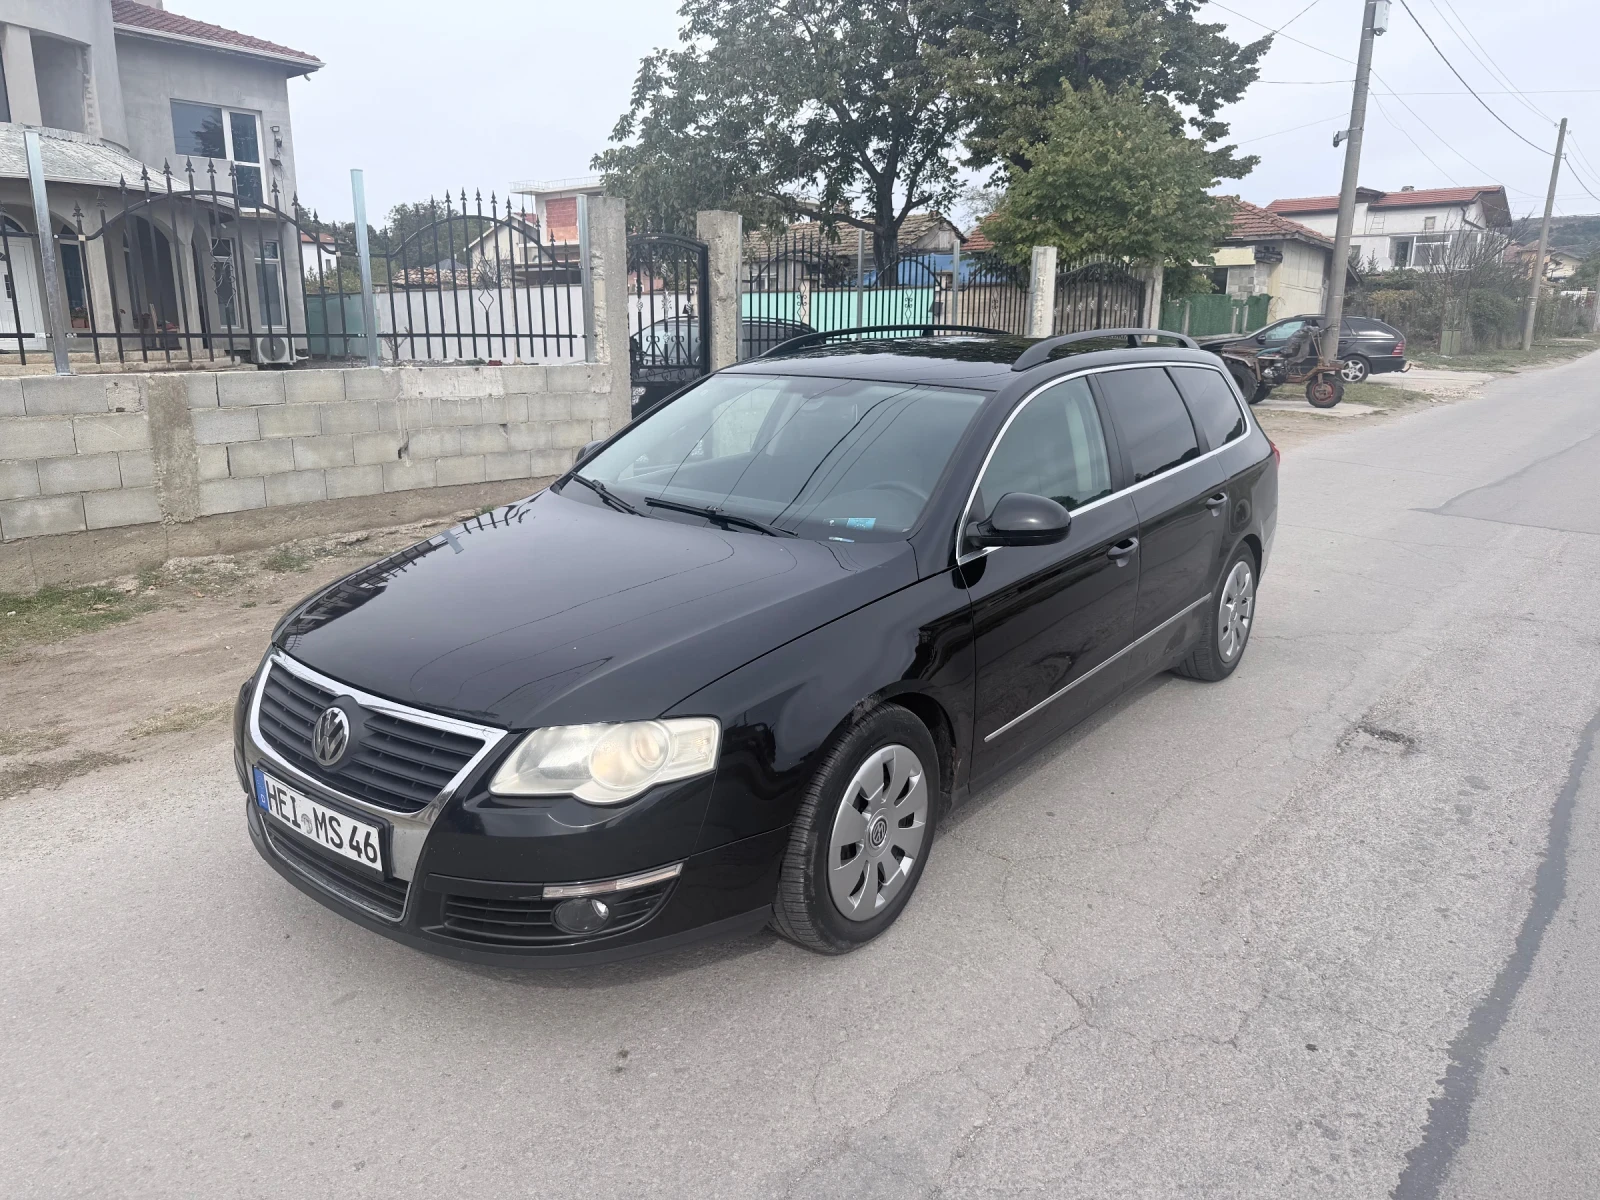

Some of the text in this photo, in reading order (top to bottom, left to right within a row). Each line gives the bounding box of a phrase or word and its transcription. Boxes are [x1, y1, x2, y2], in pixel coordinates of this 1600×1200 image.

[313, 707, 349, 766] VW
[266, 780, 378, 863] HEI MS 46
